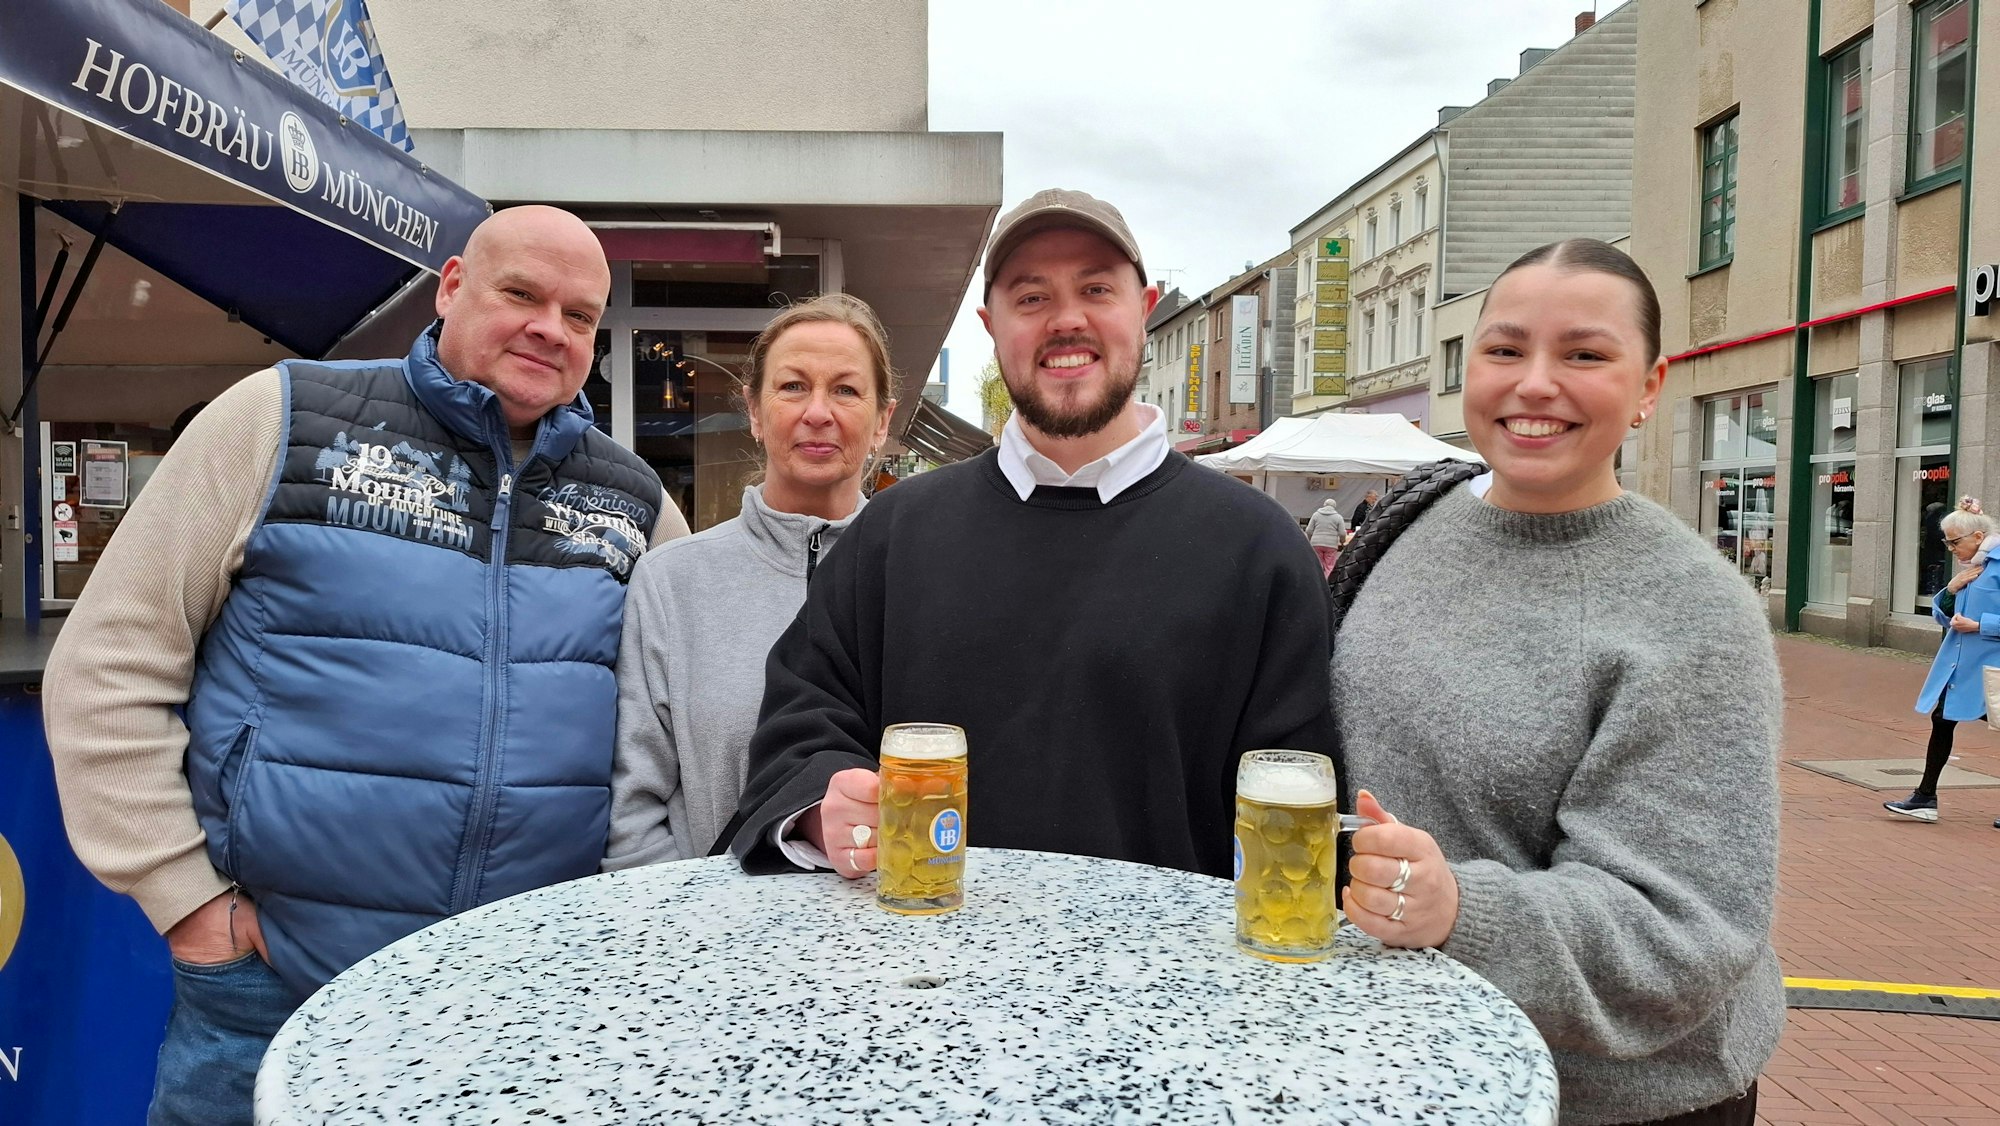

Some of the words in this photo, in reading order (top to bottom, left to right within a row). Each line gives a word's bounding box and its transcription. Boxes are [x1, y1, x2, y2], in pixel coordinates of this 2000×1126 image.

[282, 48, 336, 109] MÜNC
[71, 38, 274, 171] HOFBRÄU
[321, 162, 440, 254] MÜNCHEN
[1188, 344, 1201, 412] SPIELHALLE
[359, 443, 393, 470] 19
[326, 496, 474, 551] MOUNTAIN
[367, 494, 384, 507] OF
[390, 498, 463, 525] ADVENTURE
[412, 518, 431, 528] STATE
[549, 483, 648, 525] American
[939, 829, 957, 847] HB
